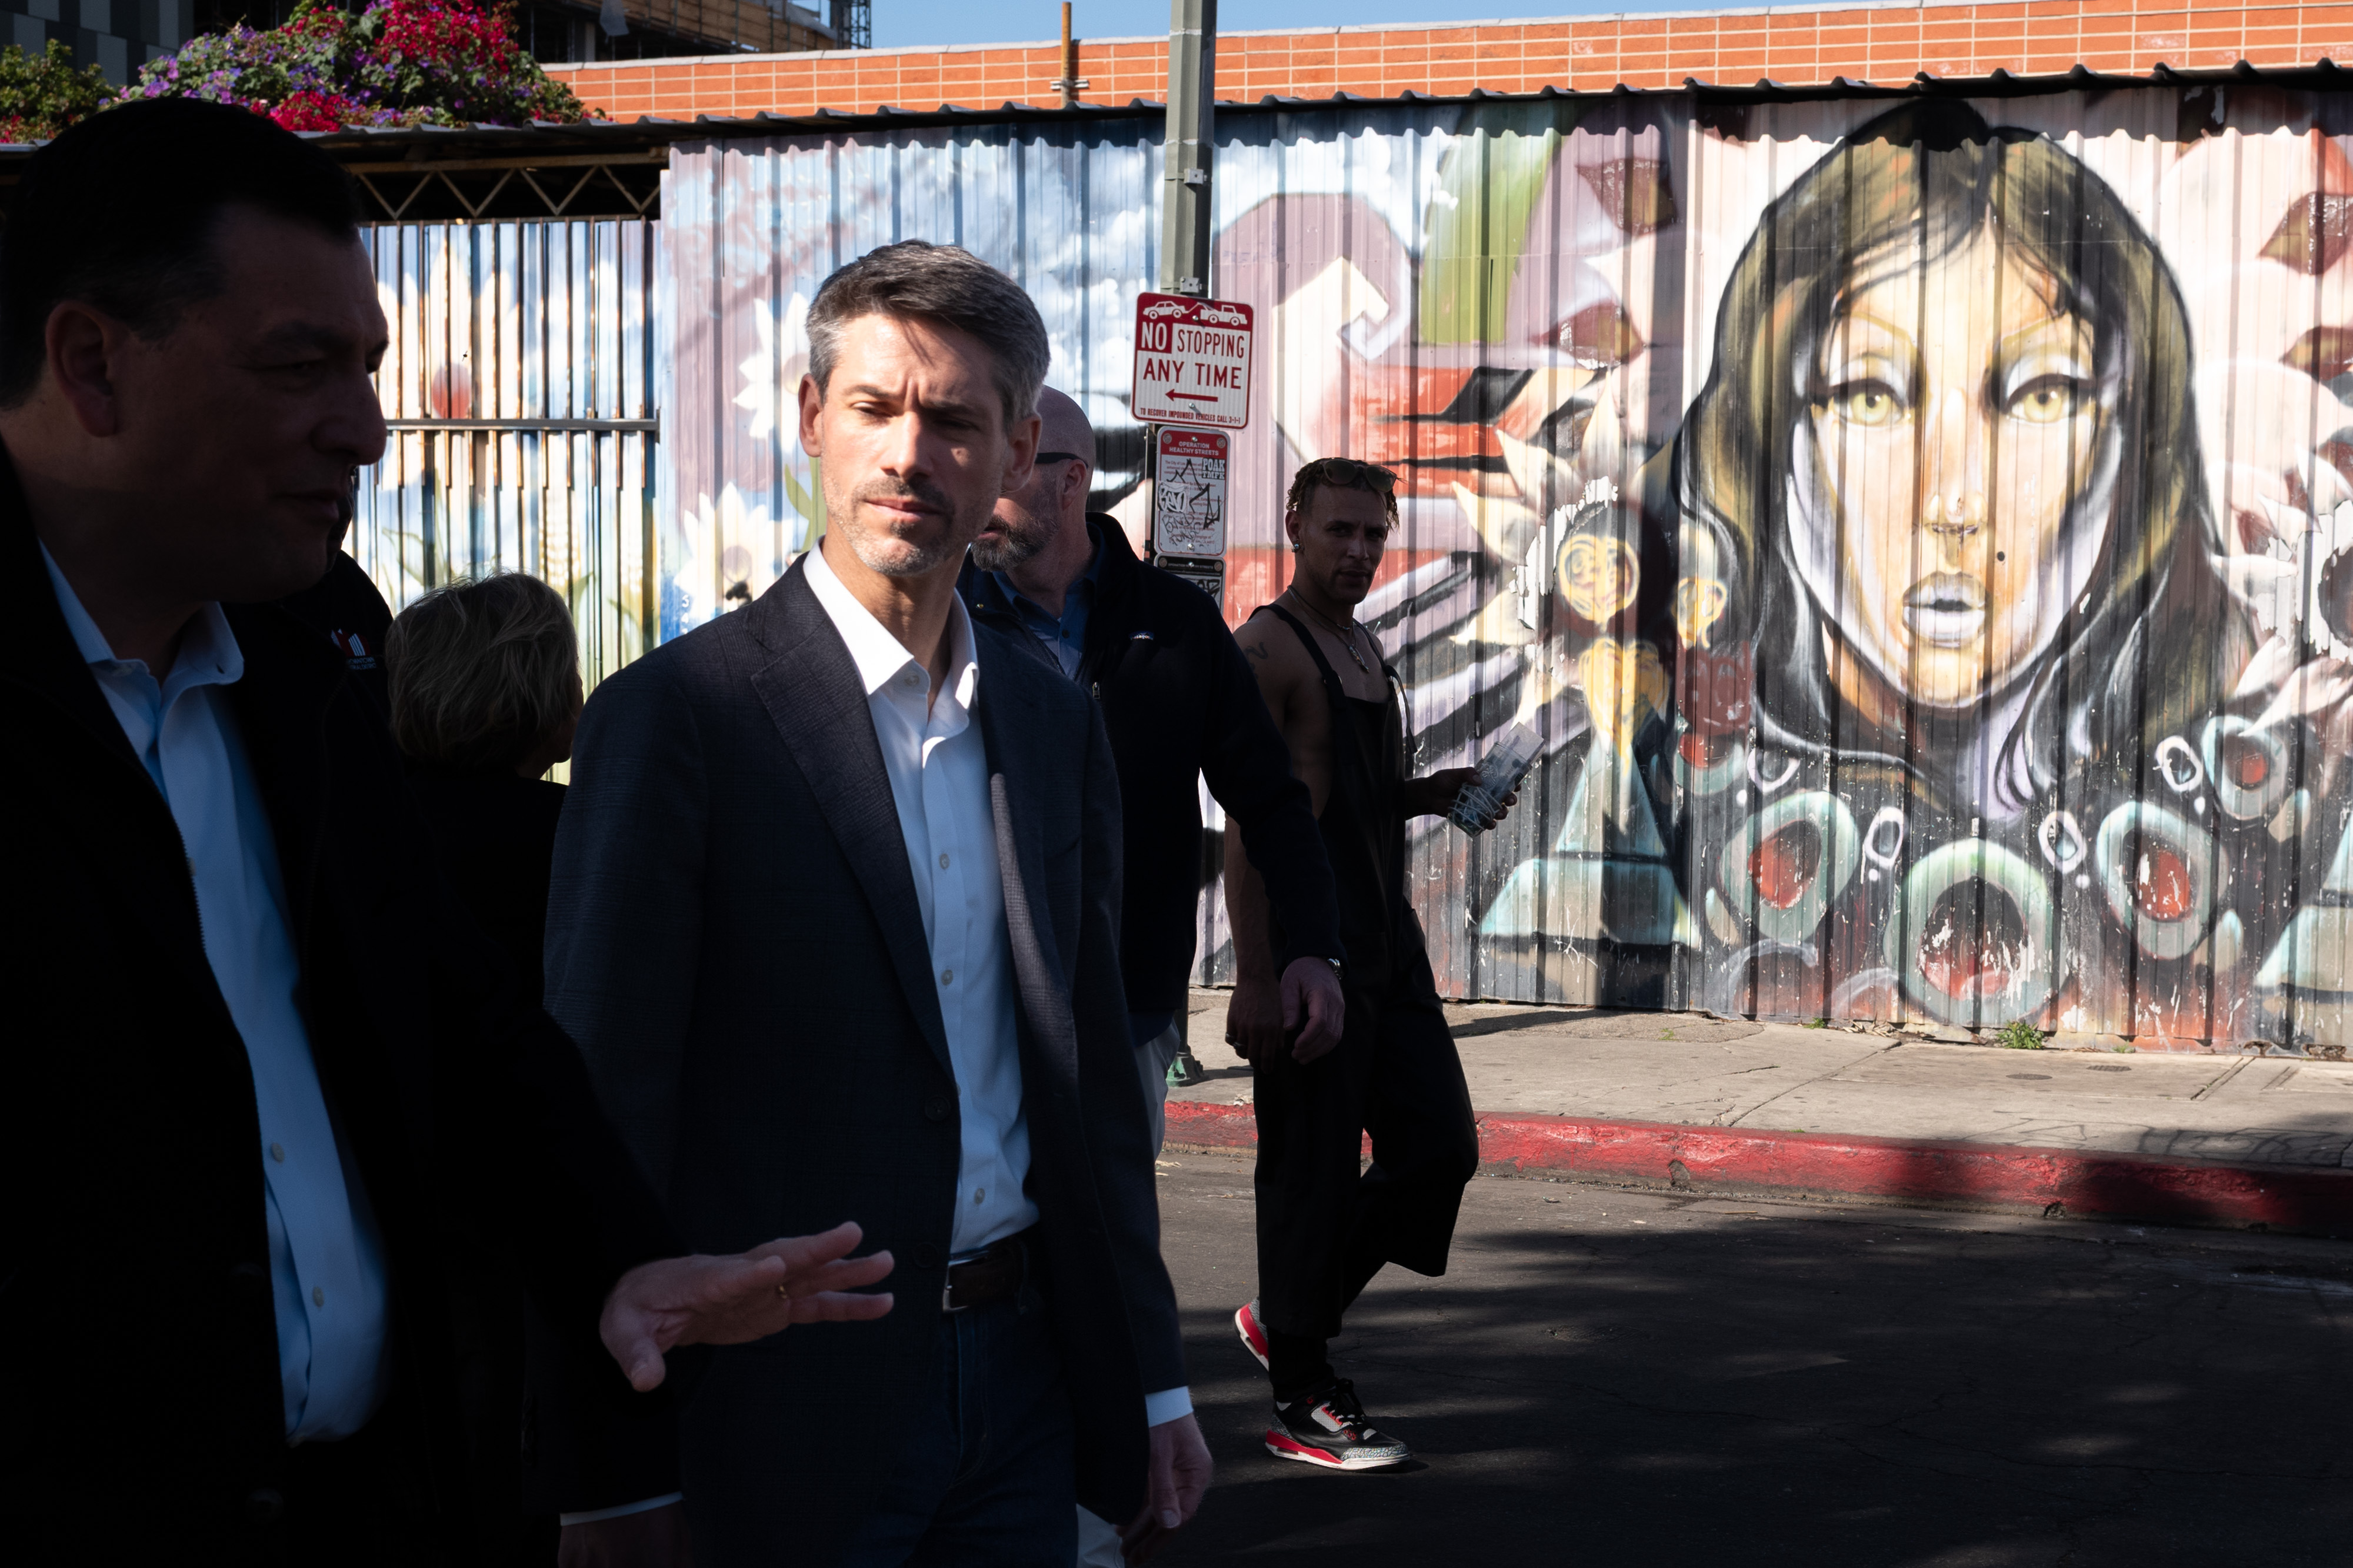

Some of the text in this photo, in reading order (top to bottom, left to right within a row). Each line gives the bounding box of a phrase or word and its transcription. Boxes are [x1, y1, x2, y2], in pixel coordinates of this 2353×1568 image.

[1141, 322, 1244, 359] NO STOPPING
[1143, 358, 1242, 389] ANY TIME
[1147, 408, 1167, 417] RECOVER
[1168, 410, 1194, 419] IMPOUNDED
[1195, 412, 1216, 422] VEHICLES
[1217, 415, 1228, 423] CALL
[1169, 446, 1194, 455] HEALTHY
[1202, 458, 1225, 472] POAK
